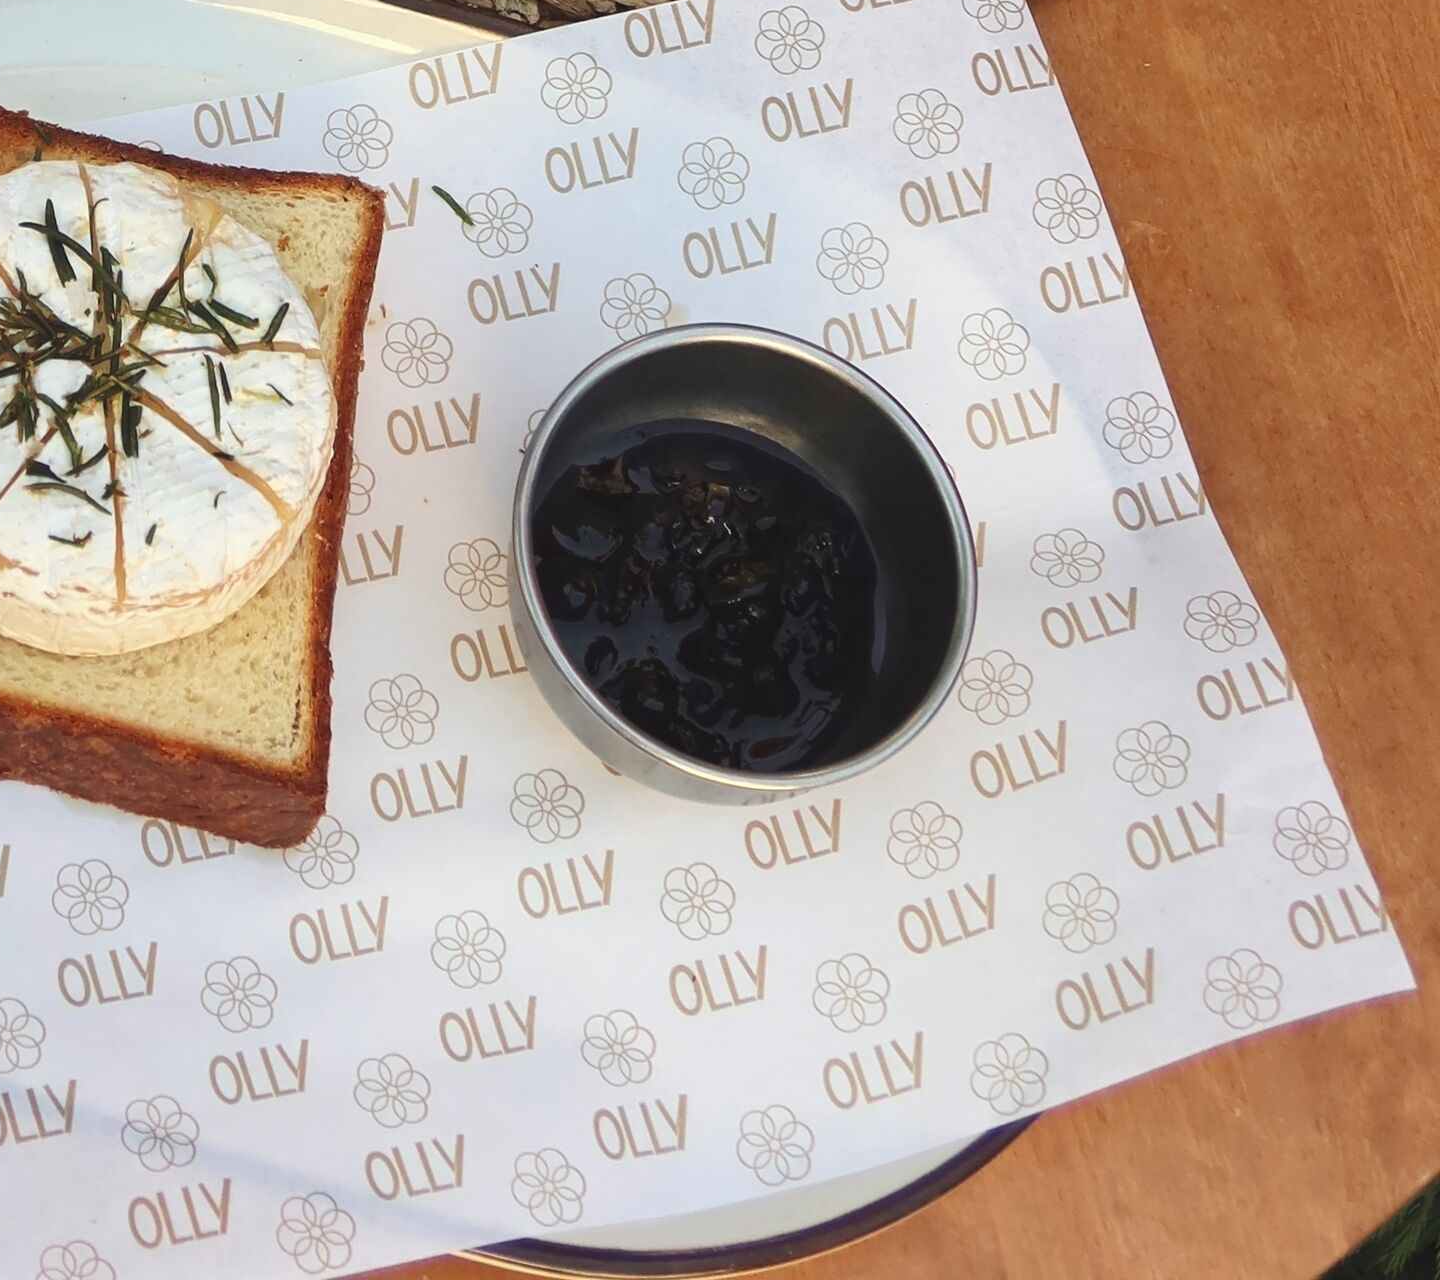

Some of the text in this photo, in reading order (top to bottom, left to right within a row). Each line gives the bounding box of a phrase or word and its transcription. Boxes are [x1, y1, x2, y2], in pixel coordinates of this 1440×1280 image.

[194, 92, 284, 148] OLLY
[761, 78, 853, 142] OLLY
[900, 163, 992, 227] OLLY
[468, 263, 560, 324] OLLY
[387, 393, 480, 455] OLLY
[966, 383, 1060, 449] OLLY
